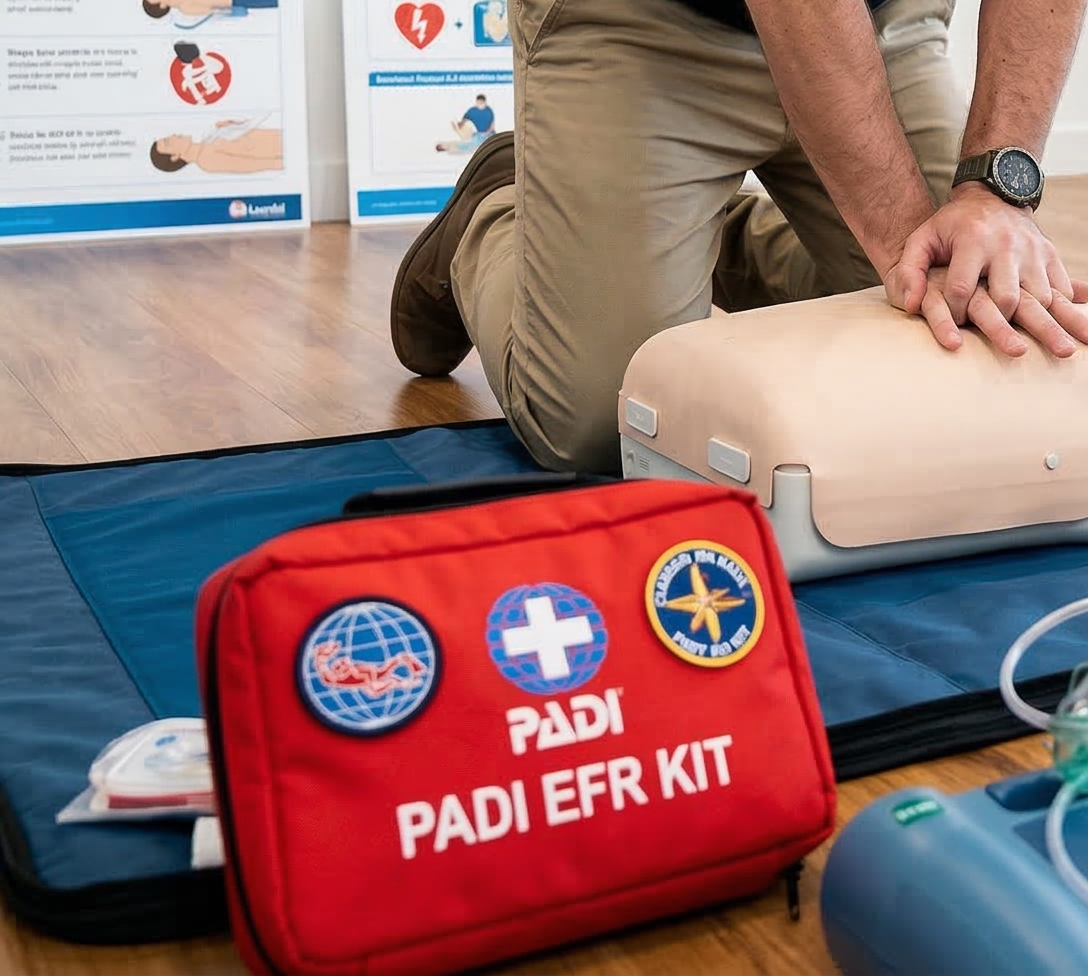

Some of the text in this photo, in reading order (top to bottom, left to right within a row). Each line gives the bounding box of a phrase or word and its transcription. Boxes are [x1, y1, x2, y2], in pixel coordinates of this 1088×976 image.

[506, 688, 624, 755] PADI
[396, 734, 733, 860] PADI EFR KIT
